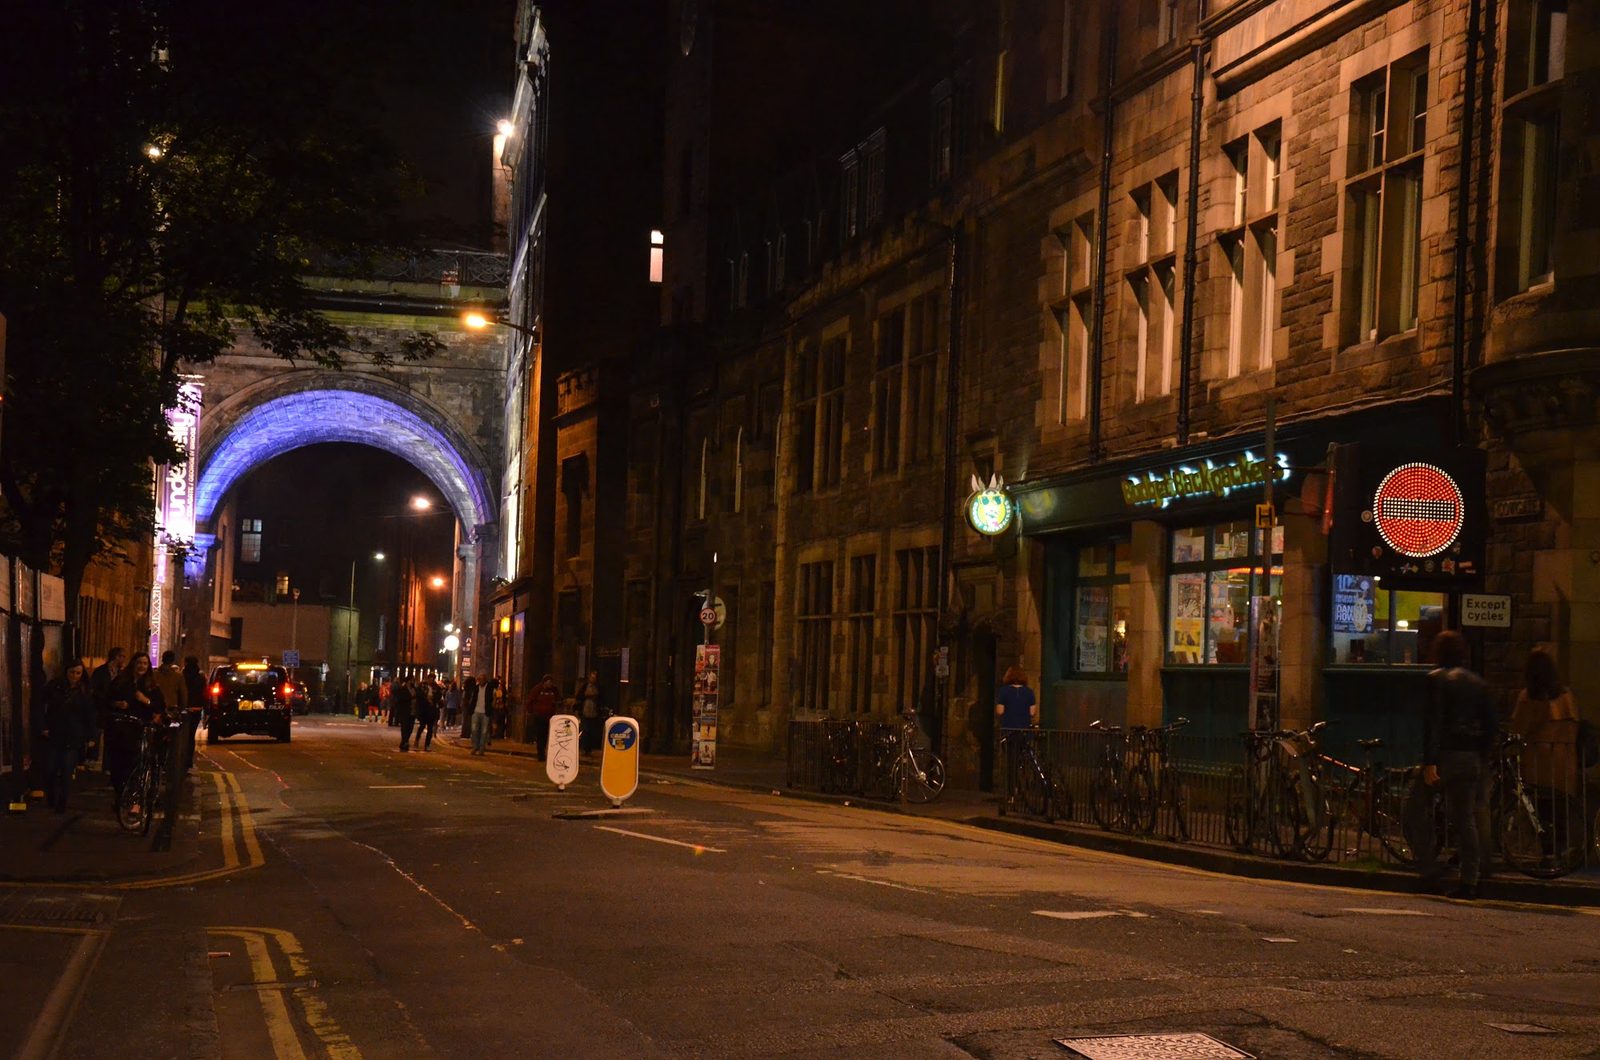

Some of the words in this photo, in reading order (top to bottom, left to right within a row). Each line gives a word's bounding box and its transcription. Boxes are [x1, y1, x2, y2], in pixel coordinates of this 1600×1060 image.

[166, 413, 195, 514] undeelly
[1120, 470, 1176, 509] Budget
[1173, 451, 1288, 497] Backpackes
[1257, 506, 1273, 526] H
[1466, 599, 1506, 611] Except
[702, 612, 714, 620] 20
[1467, 610, 1504, 621] cycles
